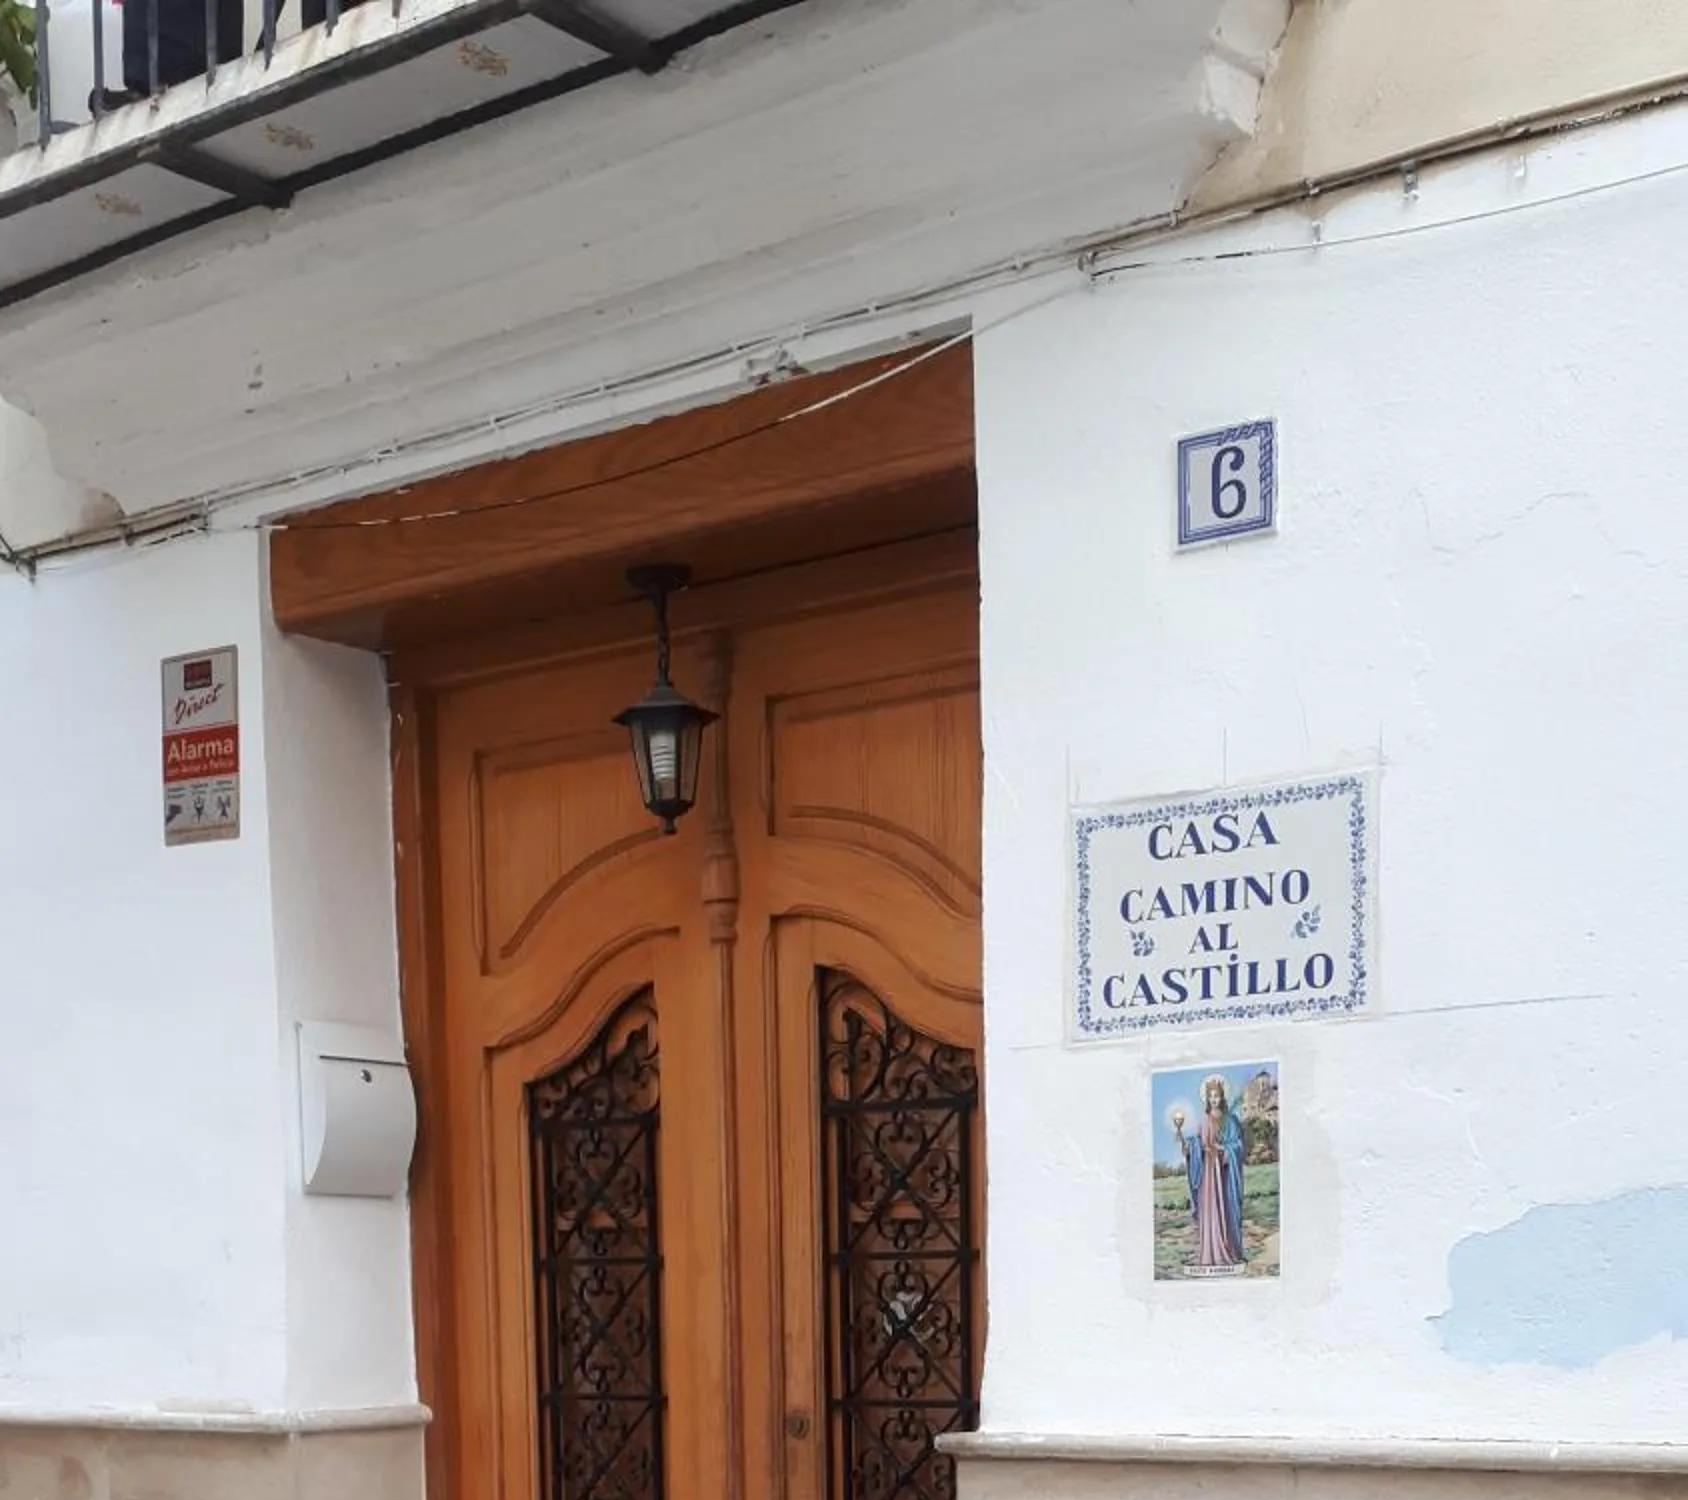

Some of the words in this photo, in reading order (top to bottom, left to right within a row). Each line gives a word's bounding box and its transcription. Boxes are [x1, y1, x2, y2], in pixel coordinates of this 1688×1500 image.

[1211, 445, 1247, 519] 6
[167, 738, 234, 765] Alarma
[1147, 810, 1280, 861] CASA
[1119, 869, 1310, 925] CAMINO
[1188, 922, 1239, 954] AL
